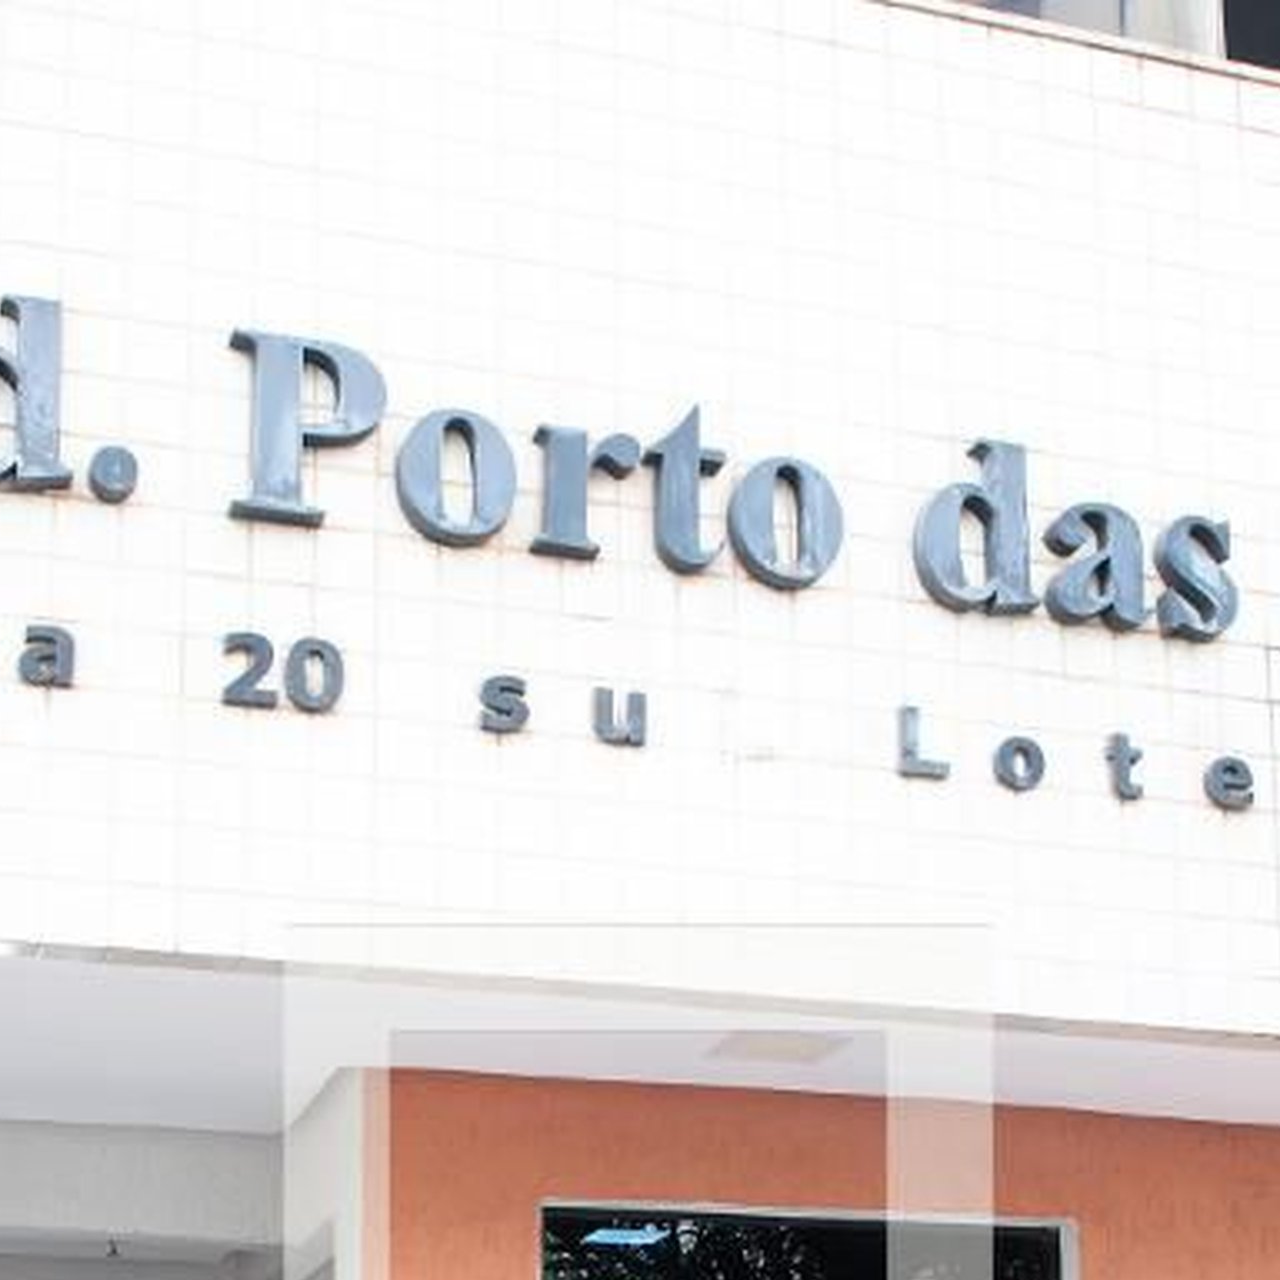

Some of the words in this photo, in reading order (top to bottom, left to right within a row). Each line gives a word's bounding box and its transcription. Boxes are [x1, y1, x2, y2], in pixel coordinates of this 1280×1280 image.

[226, 328, 844, 592] Porto
[911, 438, 1240, 646] das
[220, 631, 345, 714] 20
[897, 706, 1254, 813] Lote
